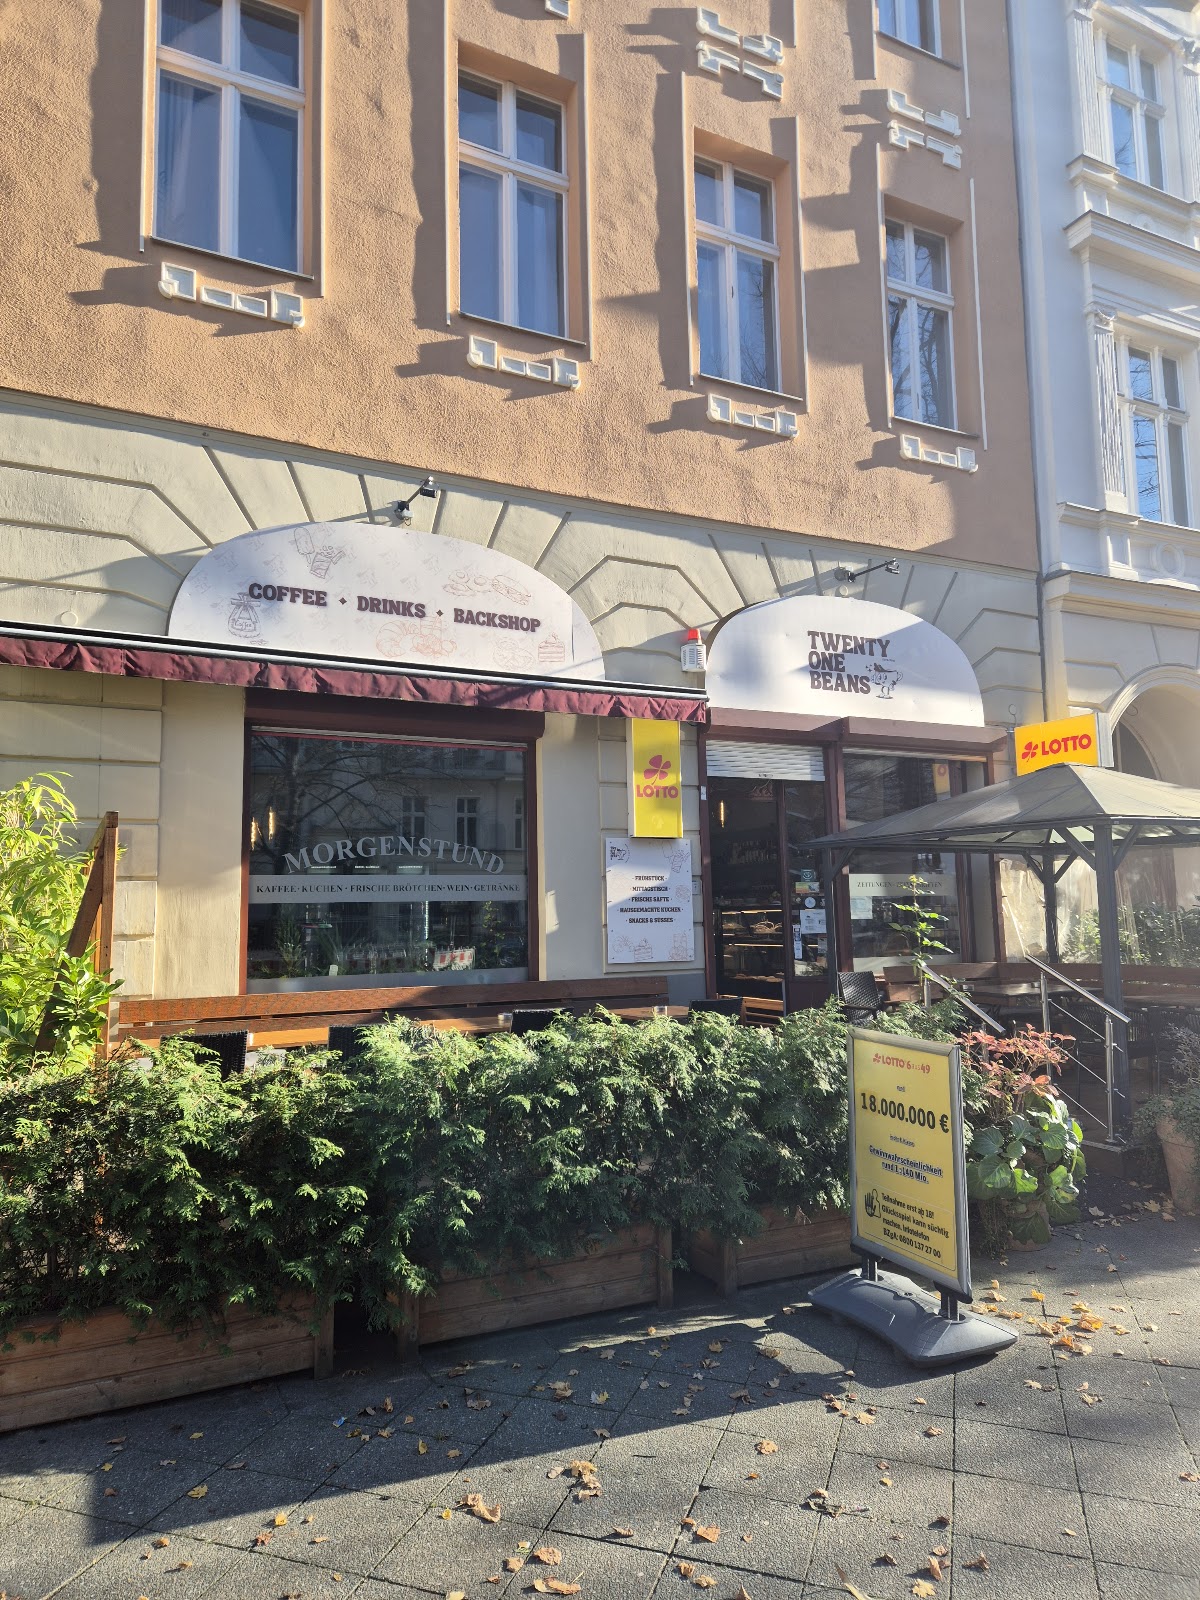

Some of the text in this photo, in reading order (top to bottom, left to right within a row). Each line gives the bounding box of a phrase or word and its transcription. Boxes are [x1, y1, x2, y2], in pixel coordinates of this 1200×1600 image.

[248, 583, 541, 632] COFFEE DRINKS BACKSHOP
[807, 630, 890, 657] TWENTY
[809, 651, 846, 672] ONE
[810, 670, 871, 694] BEANS
[1041, 734, 1092, 755] LOTTO
[636, 784, 678, 799] LOTTO
[282, 836, 504, 874] MORGENSTUND
[256, 882, 520, 893] KAFFEE KUCHEN FRISCHE BRÖTCHEN WEIN GETRÄNKE
[882, 1055, 905, 1069] LOTTO
[861, 1093, 949, 1134] 18.000.000 €
[907, 1204, 917, 1213] erst
[912, 1216, 926, 1228] kann
[925, 1246, 932, 1255] 27
